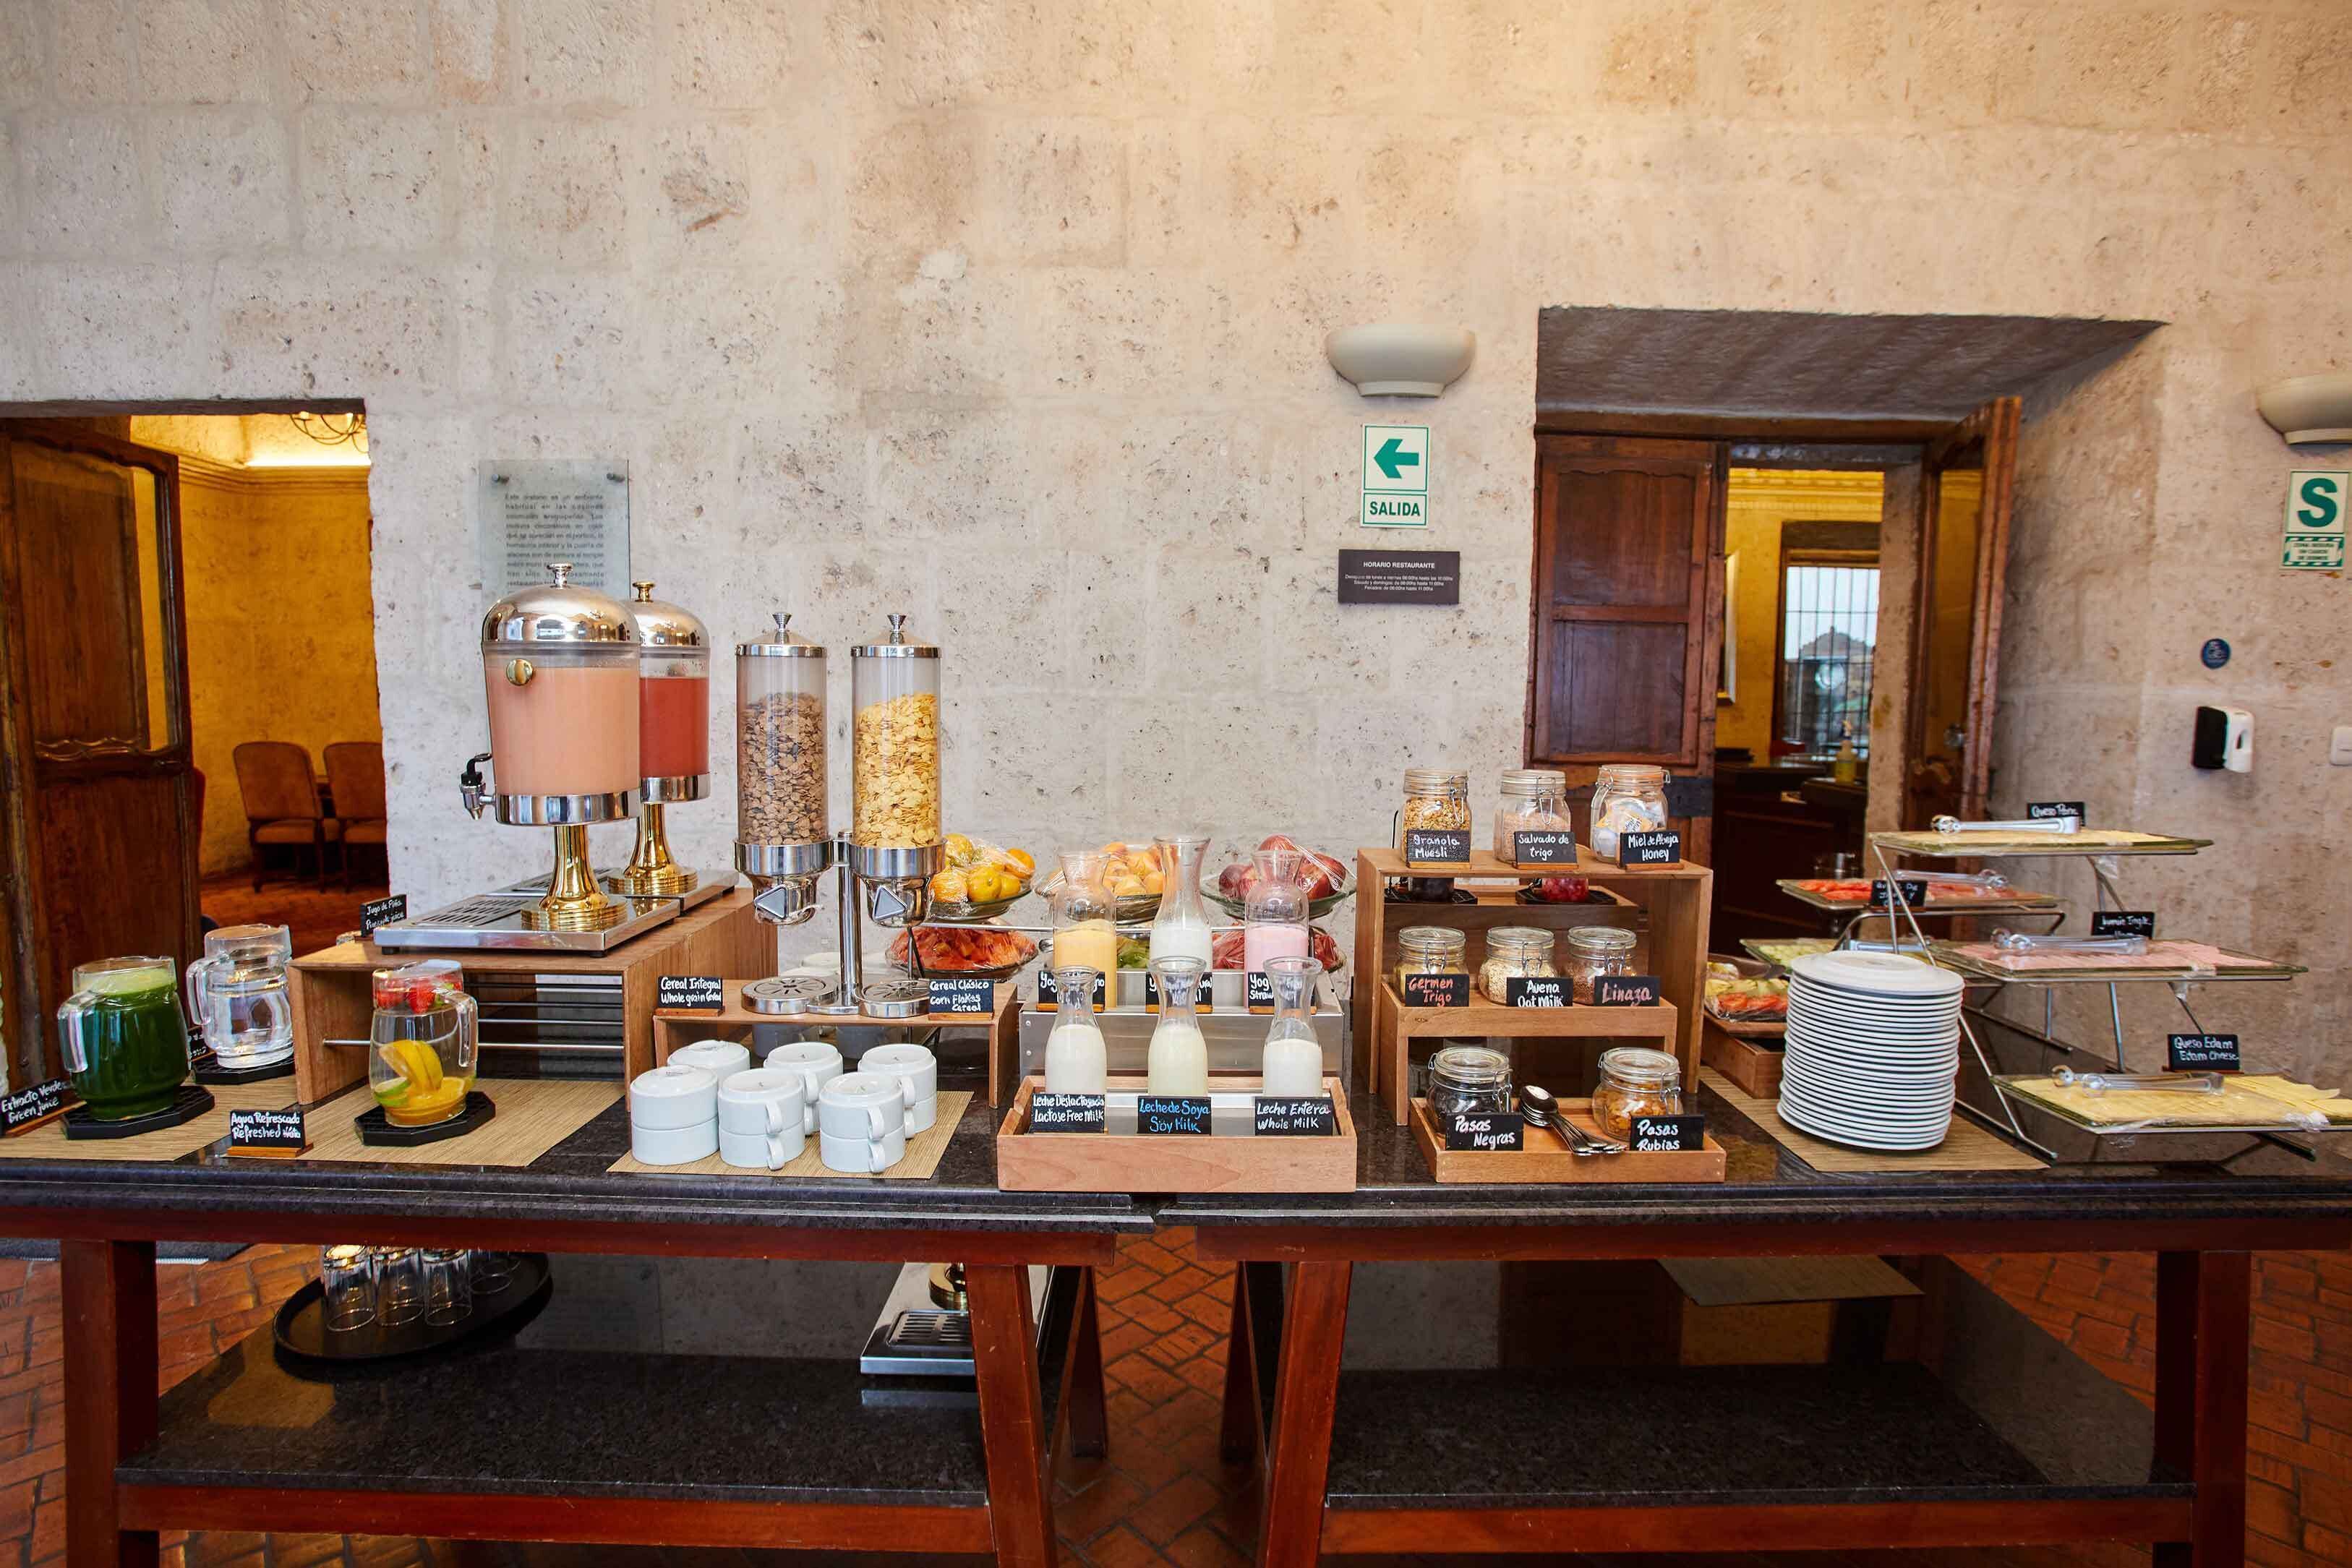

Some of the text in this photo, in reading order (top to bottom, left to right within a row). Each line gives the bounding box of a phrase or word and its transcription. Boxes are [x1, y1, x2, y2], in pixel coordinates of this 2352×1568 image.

[1369, 501, 1420, 516] SALIDA
[2298, 478, 2337, 528] S
[1518, 834, 1569, 844] Salvado de
[1628, 834, 1646, 848] Miel
[1647, 836, 1656, 846] de
[1415, 846, 1447, 858] Muesli
[1642, 849, 1669, 862] Honey
[367, 906, 381, 916] Jugo
[381, 901, 388, 911] de
[661, 977, 722, 992] Cereal Integral
[930, 980, 990, 991] Cereal Clásico
[1408, 977, 1453, 991] Germen
[661, 992, 685, 1003] Whole
[685, 991, 706, 1006] grain
[1423, 990, 1452, 1007] Trigo
[1518, 995, 1536, 1007] Oat
[1602, 982, 1653, 1007] Linaza
[952, 1002, 981, 1011] Cereal
[2173, 1036, 2233, 1049] Queso Edam
[1, 1080, 62, 1113] Extracto Verde
[1033, 1094, 1056, 1106] Leche
[9, 1106, 37, 1124] Green
[1034, 1108, 1105, 1123] Lactose Free Milk
[1181, 1100, 1211, 1120] Soya
[1257, 1100, 1331, 1116] Leche Entera
[231, 1112, 254, 1128] Agua
[1150, 1115, 1173, 1134] Soy
[1257, 1117, 1320, 1130] Whole Milk
[1455, 1115, 1492, 1134] Pasas
[1637, 1119, 1679, 1136] Pasas
[232, 1123, 281, 1143] Refreshed
[1474, 1131, 1516, 1151] Negras
[1637, 1138, 1680, 1151] Rubias
